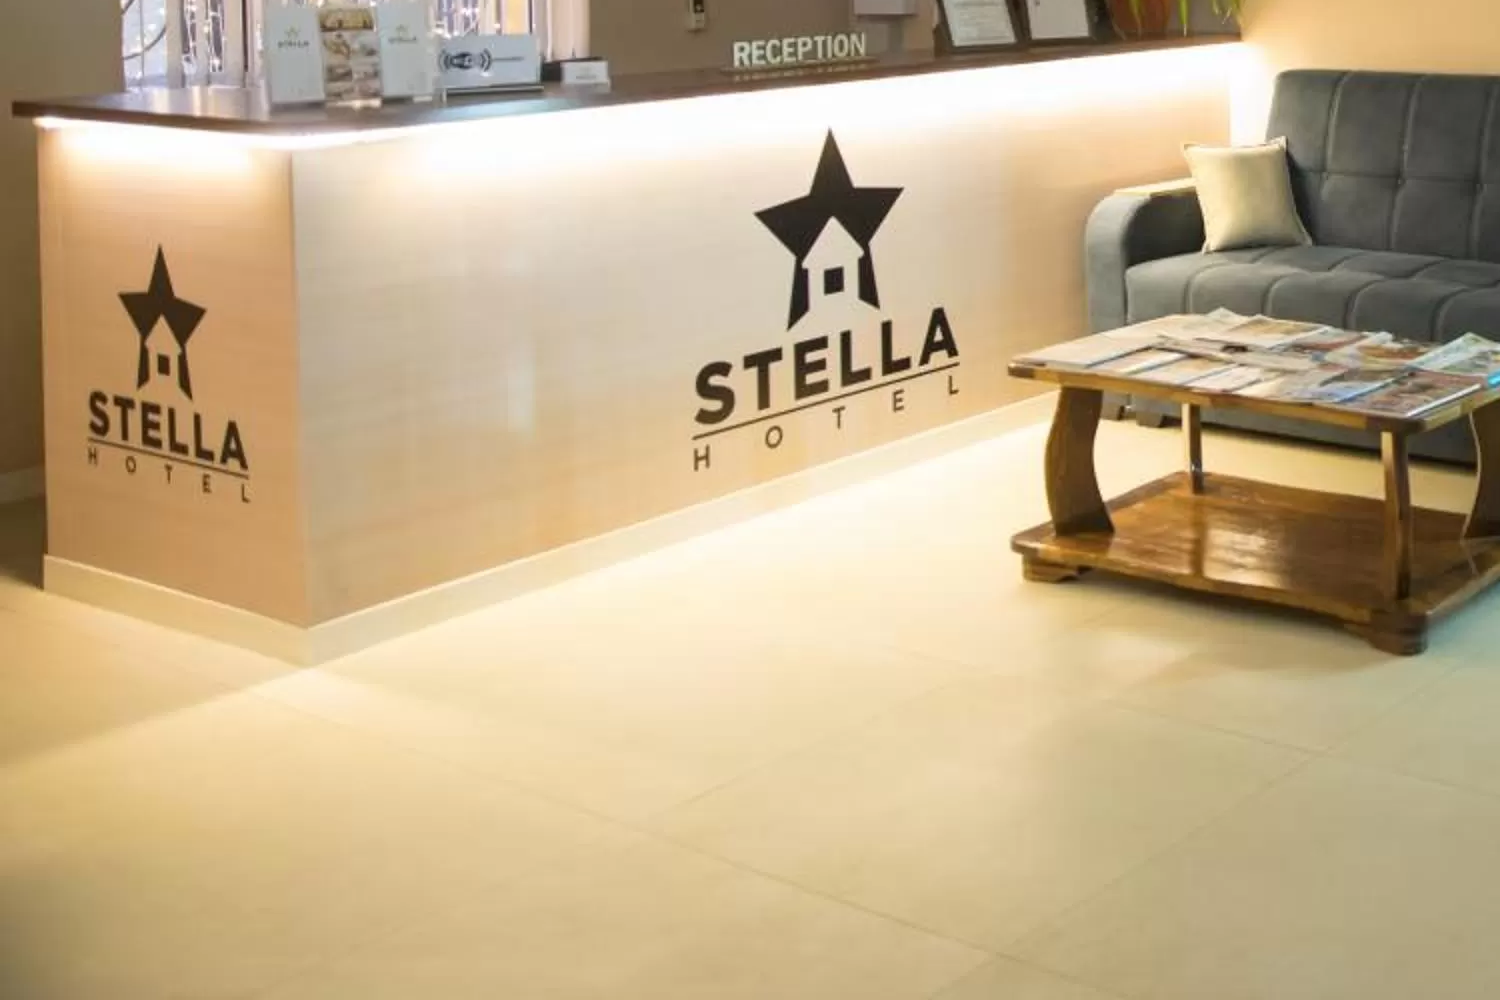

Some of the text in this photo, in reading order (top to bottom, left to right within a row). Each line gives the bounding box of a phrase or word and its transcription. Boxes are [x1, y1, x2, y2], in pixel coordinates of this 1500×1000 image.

[733, 32, 866, 68] RECEPTION
[694, 306, 960, 425] STELLA
[89, 390, 249, 471] STELLA
[692, 375, 960, 472] HOTEL
[87, 446, 251, 504] HOTEL
